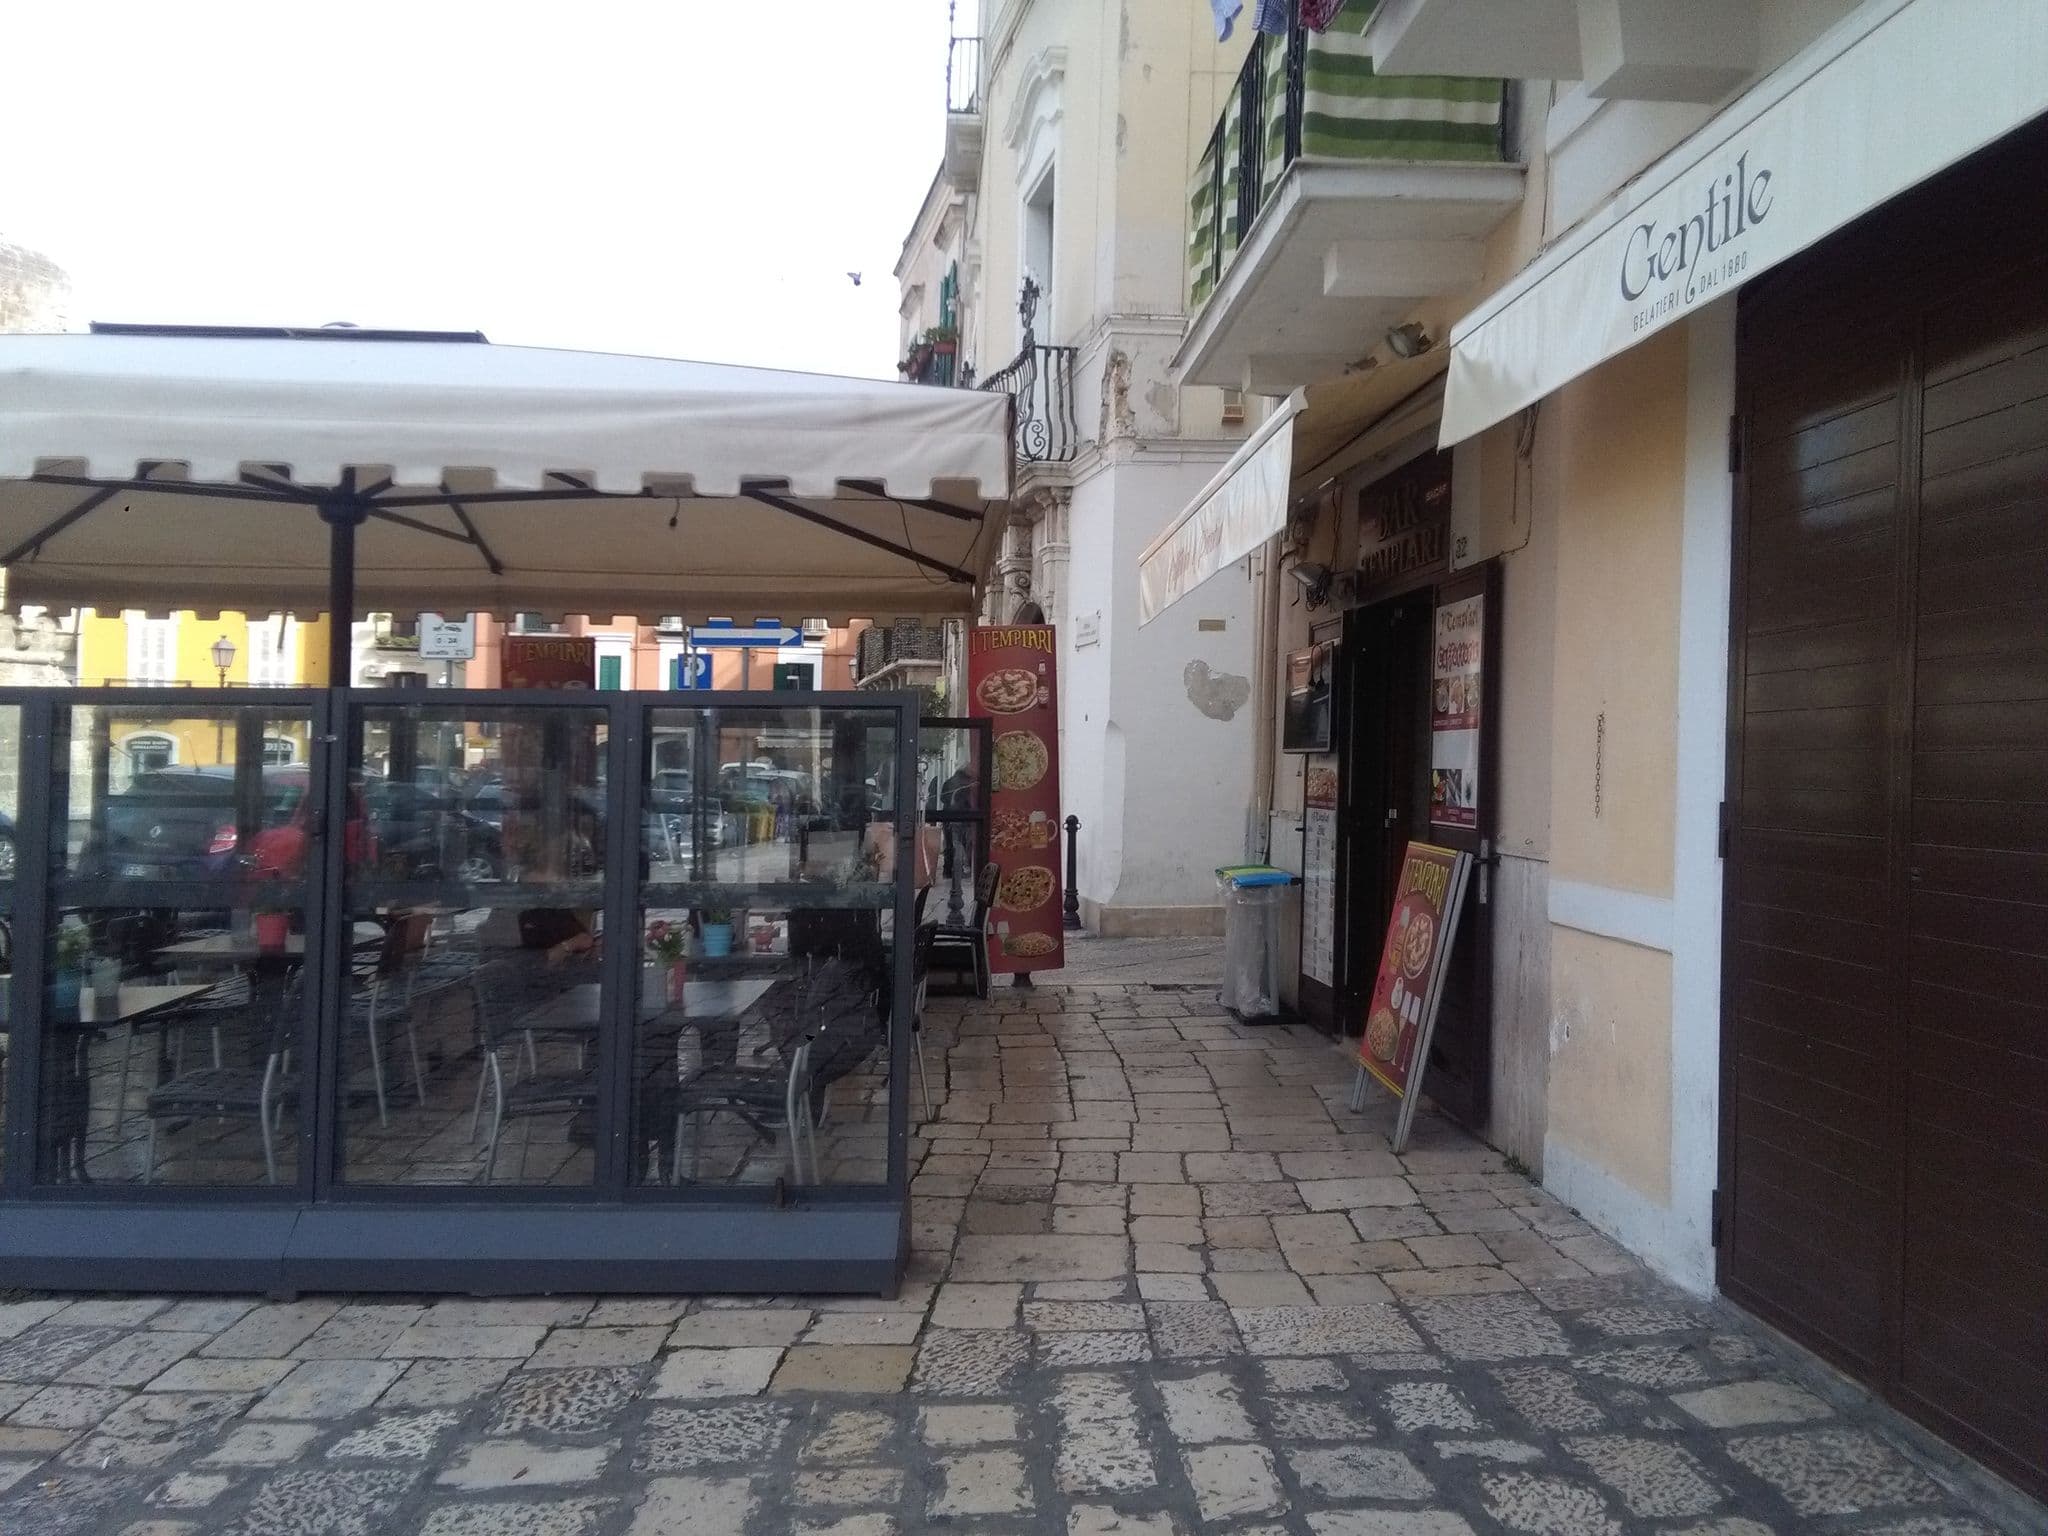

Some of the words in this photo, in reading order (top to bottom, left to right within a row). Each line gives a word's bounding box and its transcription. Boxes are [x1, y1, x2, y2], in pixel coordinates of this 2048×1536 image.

[1621, 150, 1773, 304] Gentile
[1633, 290, 1680, 332] GELATIERI
[1700, 269, 1718, 293] DAL
[1378, 480, 1420, 542] BAR
[1361, 527, 1441, 577] TEMPLARI
[513, 640, 593, 666] TEMPLARI
[971, 632, 977, 656] I
[979, 629, 1053, 655] TEMPLARI
[683, 656, 706, 687] P
